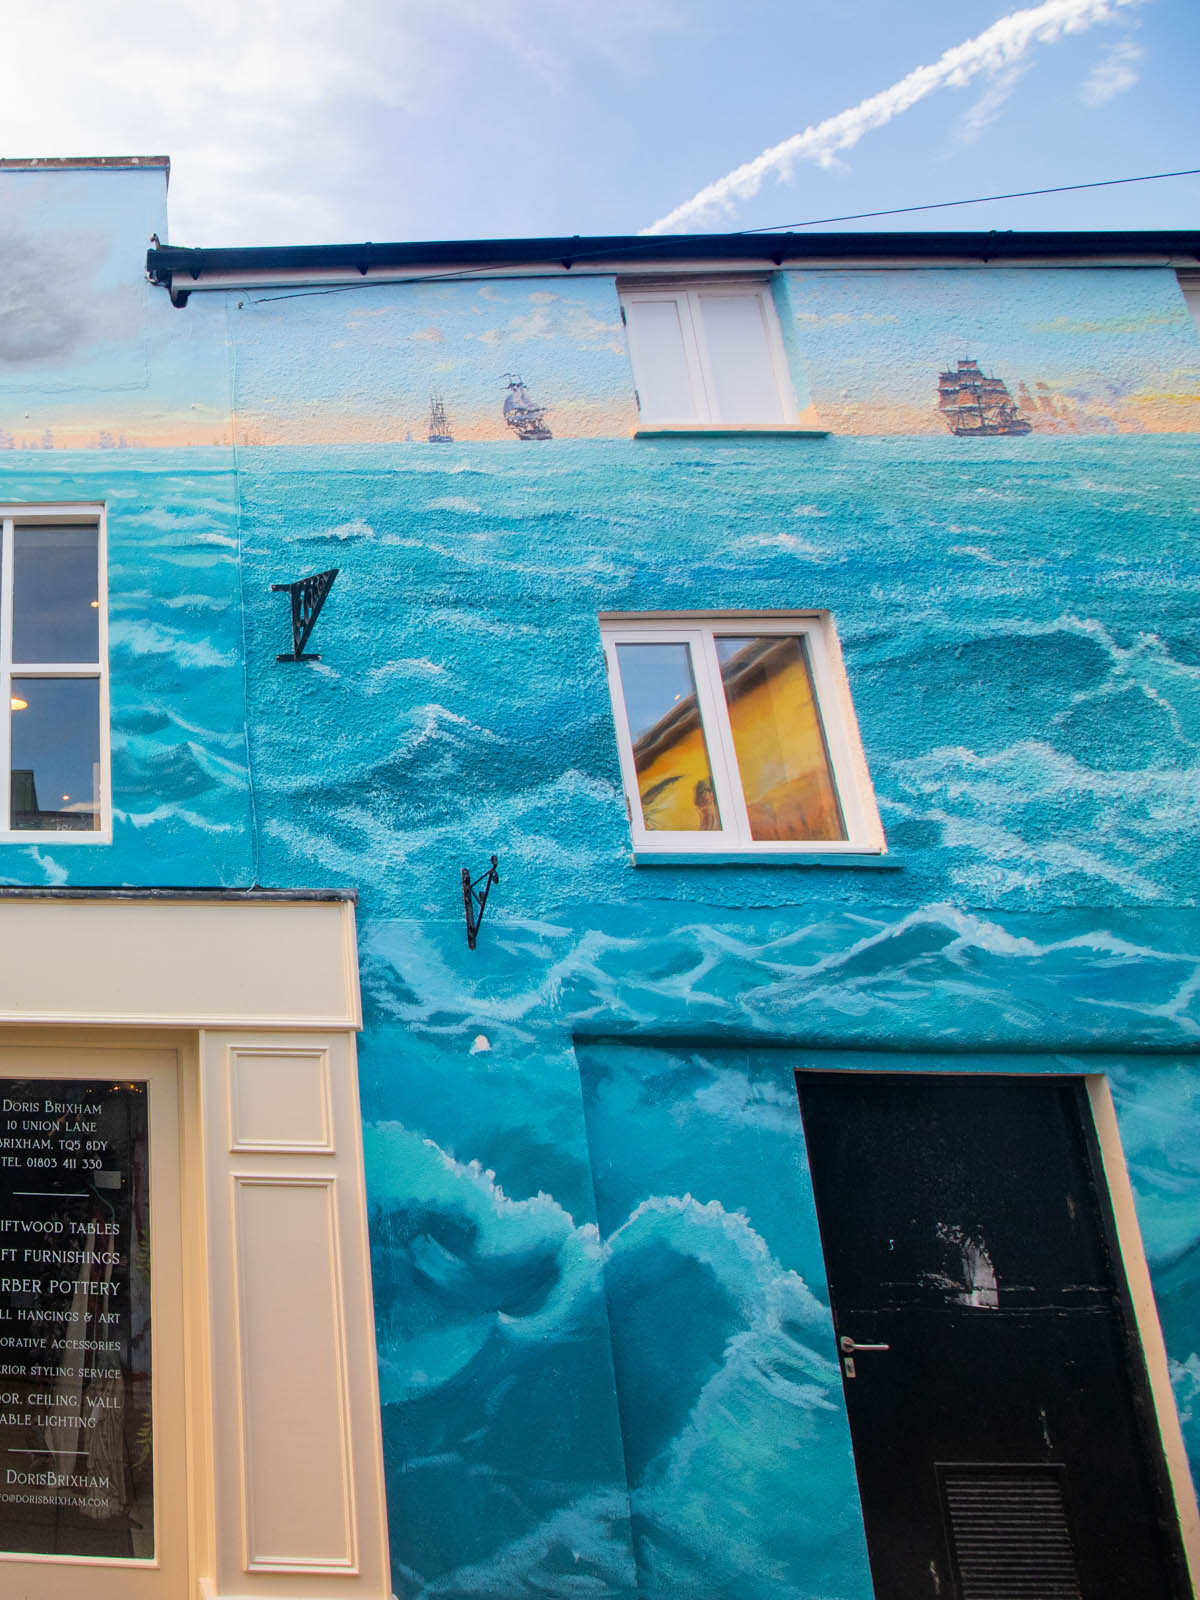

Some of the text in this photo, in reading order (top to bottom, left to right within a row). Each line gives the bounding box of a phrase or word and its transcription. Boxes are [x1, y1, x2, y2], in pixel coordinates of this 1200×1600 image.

[3, 1099, 102, 1115] DORIS BRIXHAM
[7, 1120, 97, 1132] 10 UNION LANE
[59, 1139, 80, 1151] TQ5
[85, 1140, 108, 1151] 8DY
[1, 1156, 102, 1169] TEL 01803 411 330
[69, 1222, 120, 1235] TABLES
[24, 1249, 120, 1265] FURNISHINGS
[49, 1280, 120, 1295] POTTERY
[17, 1309, 79, 1322] HANGINGS
[83, 1312, 92, 1322] &
[98, 1313, 120, 1324] ART
[51, 1339, 121, 1351] ACCESSORIES
[30, 1366, 74, 1377] STYLING
[78, 1368, 120, 1379] SERVICE
[86, 1396, 120, 1409] WALL
[37, 1415, 96, 1428] LIGHTING
